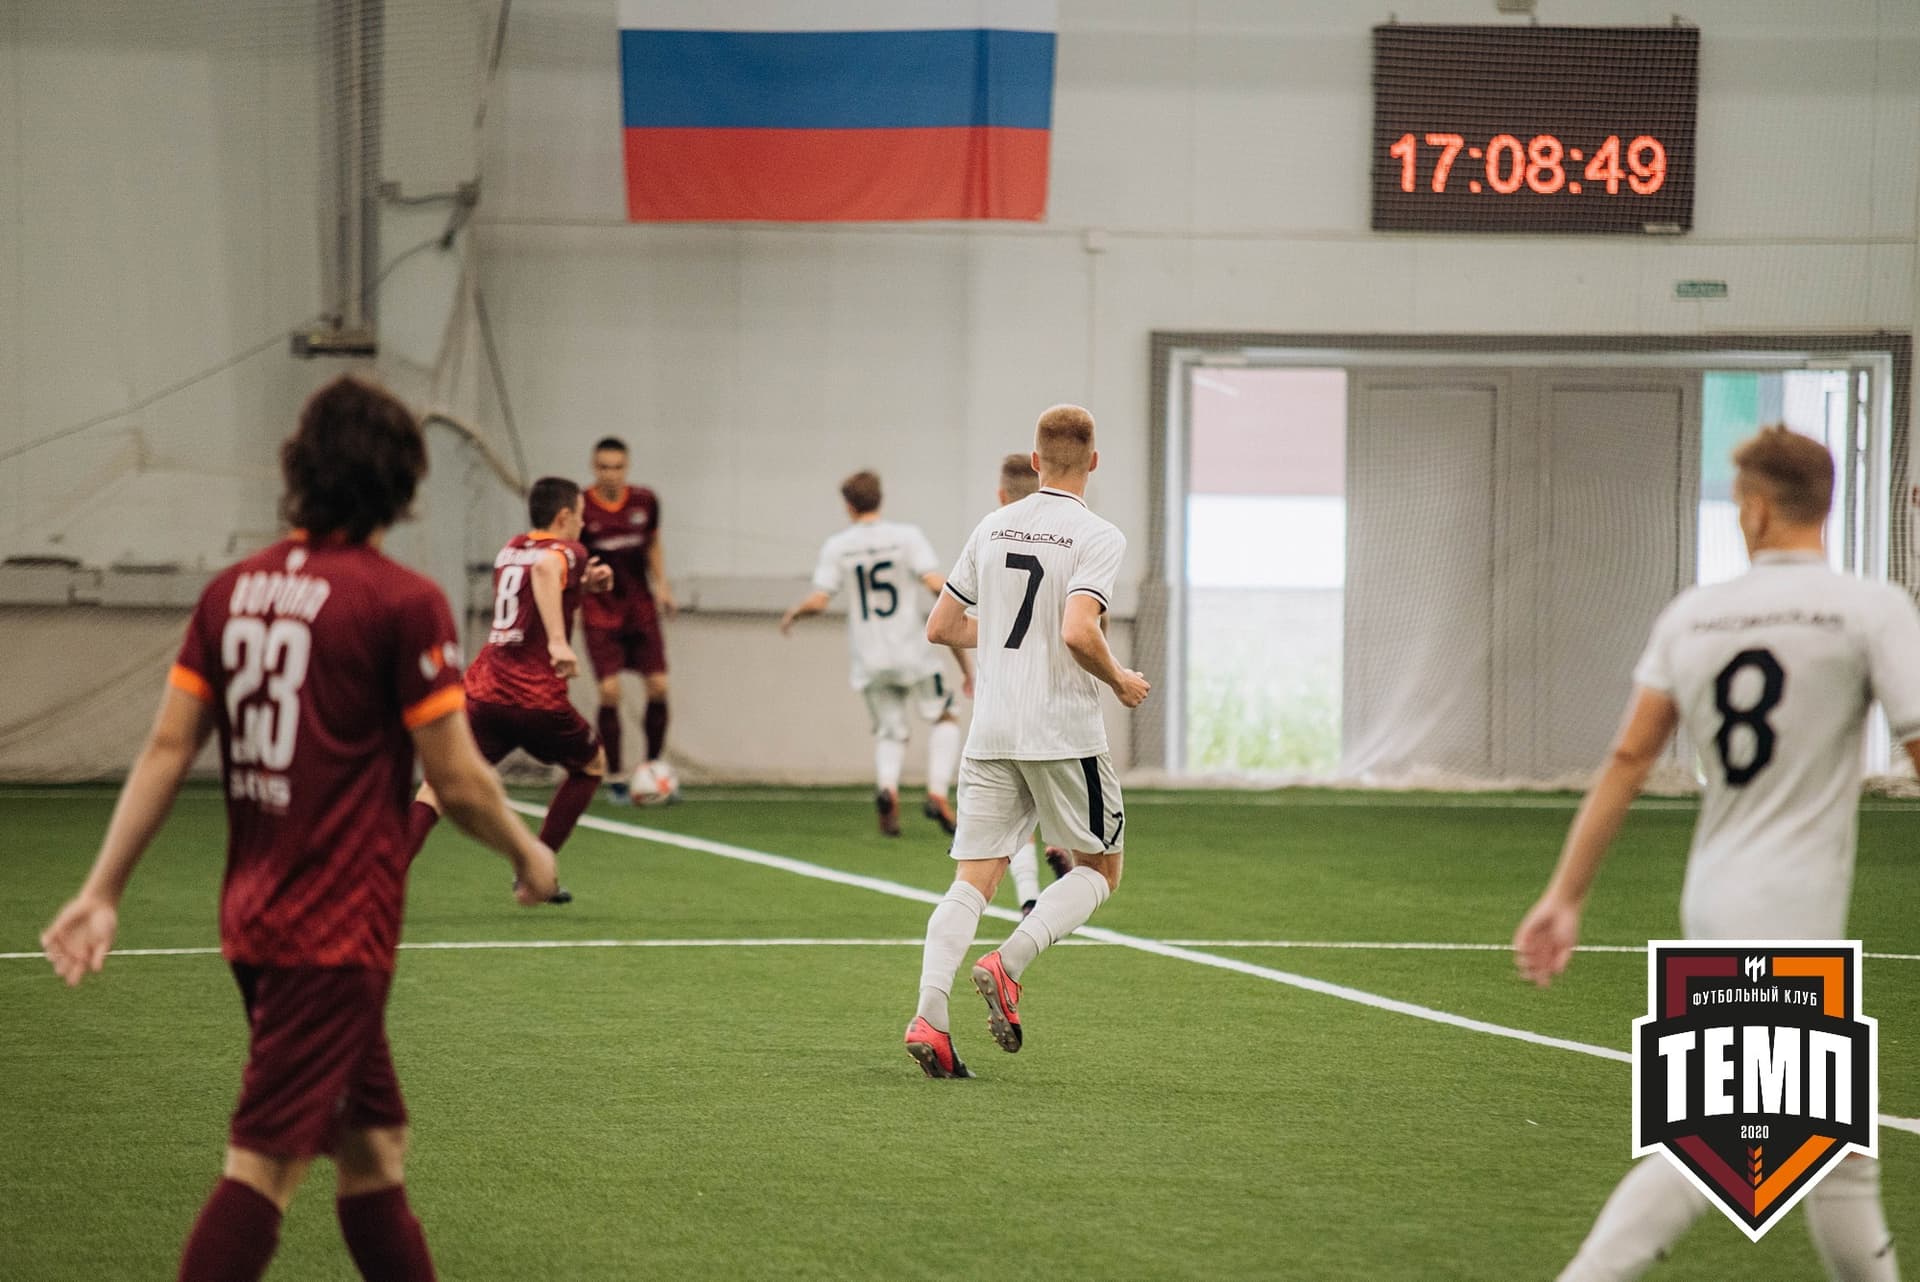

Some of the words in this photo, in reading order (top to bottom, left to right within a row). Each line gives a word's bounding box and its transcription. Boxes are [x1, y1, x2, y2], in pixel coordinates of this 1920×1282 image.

[1389, 133, 1667, 195] 17:08:49
[492, 565, 525, 630] 8
[855, 560, 899, 621] 15
[1003, 552, 1045, 650] 7
[221, 616, 311, 772] 23
[1715, 648, 1785, 786] 8
